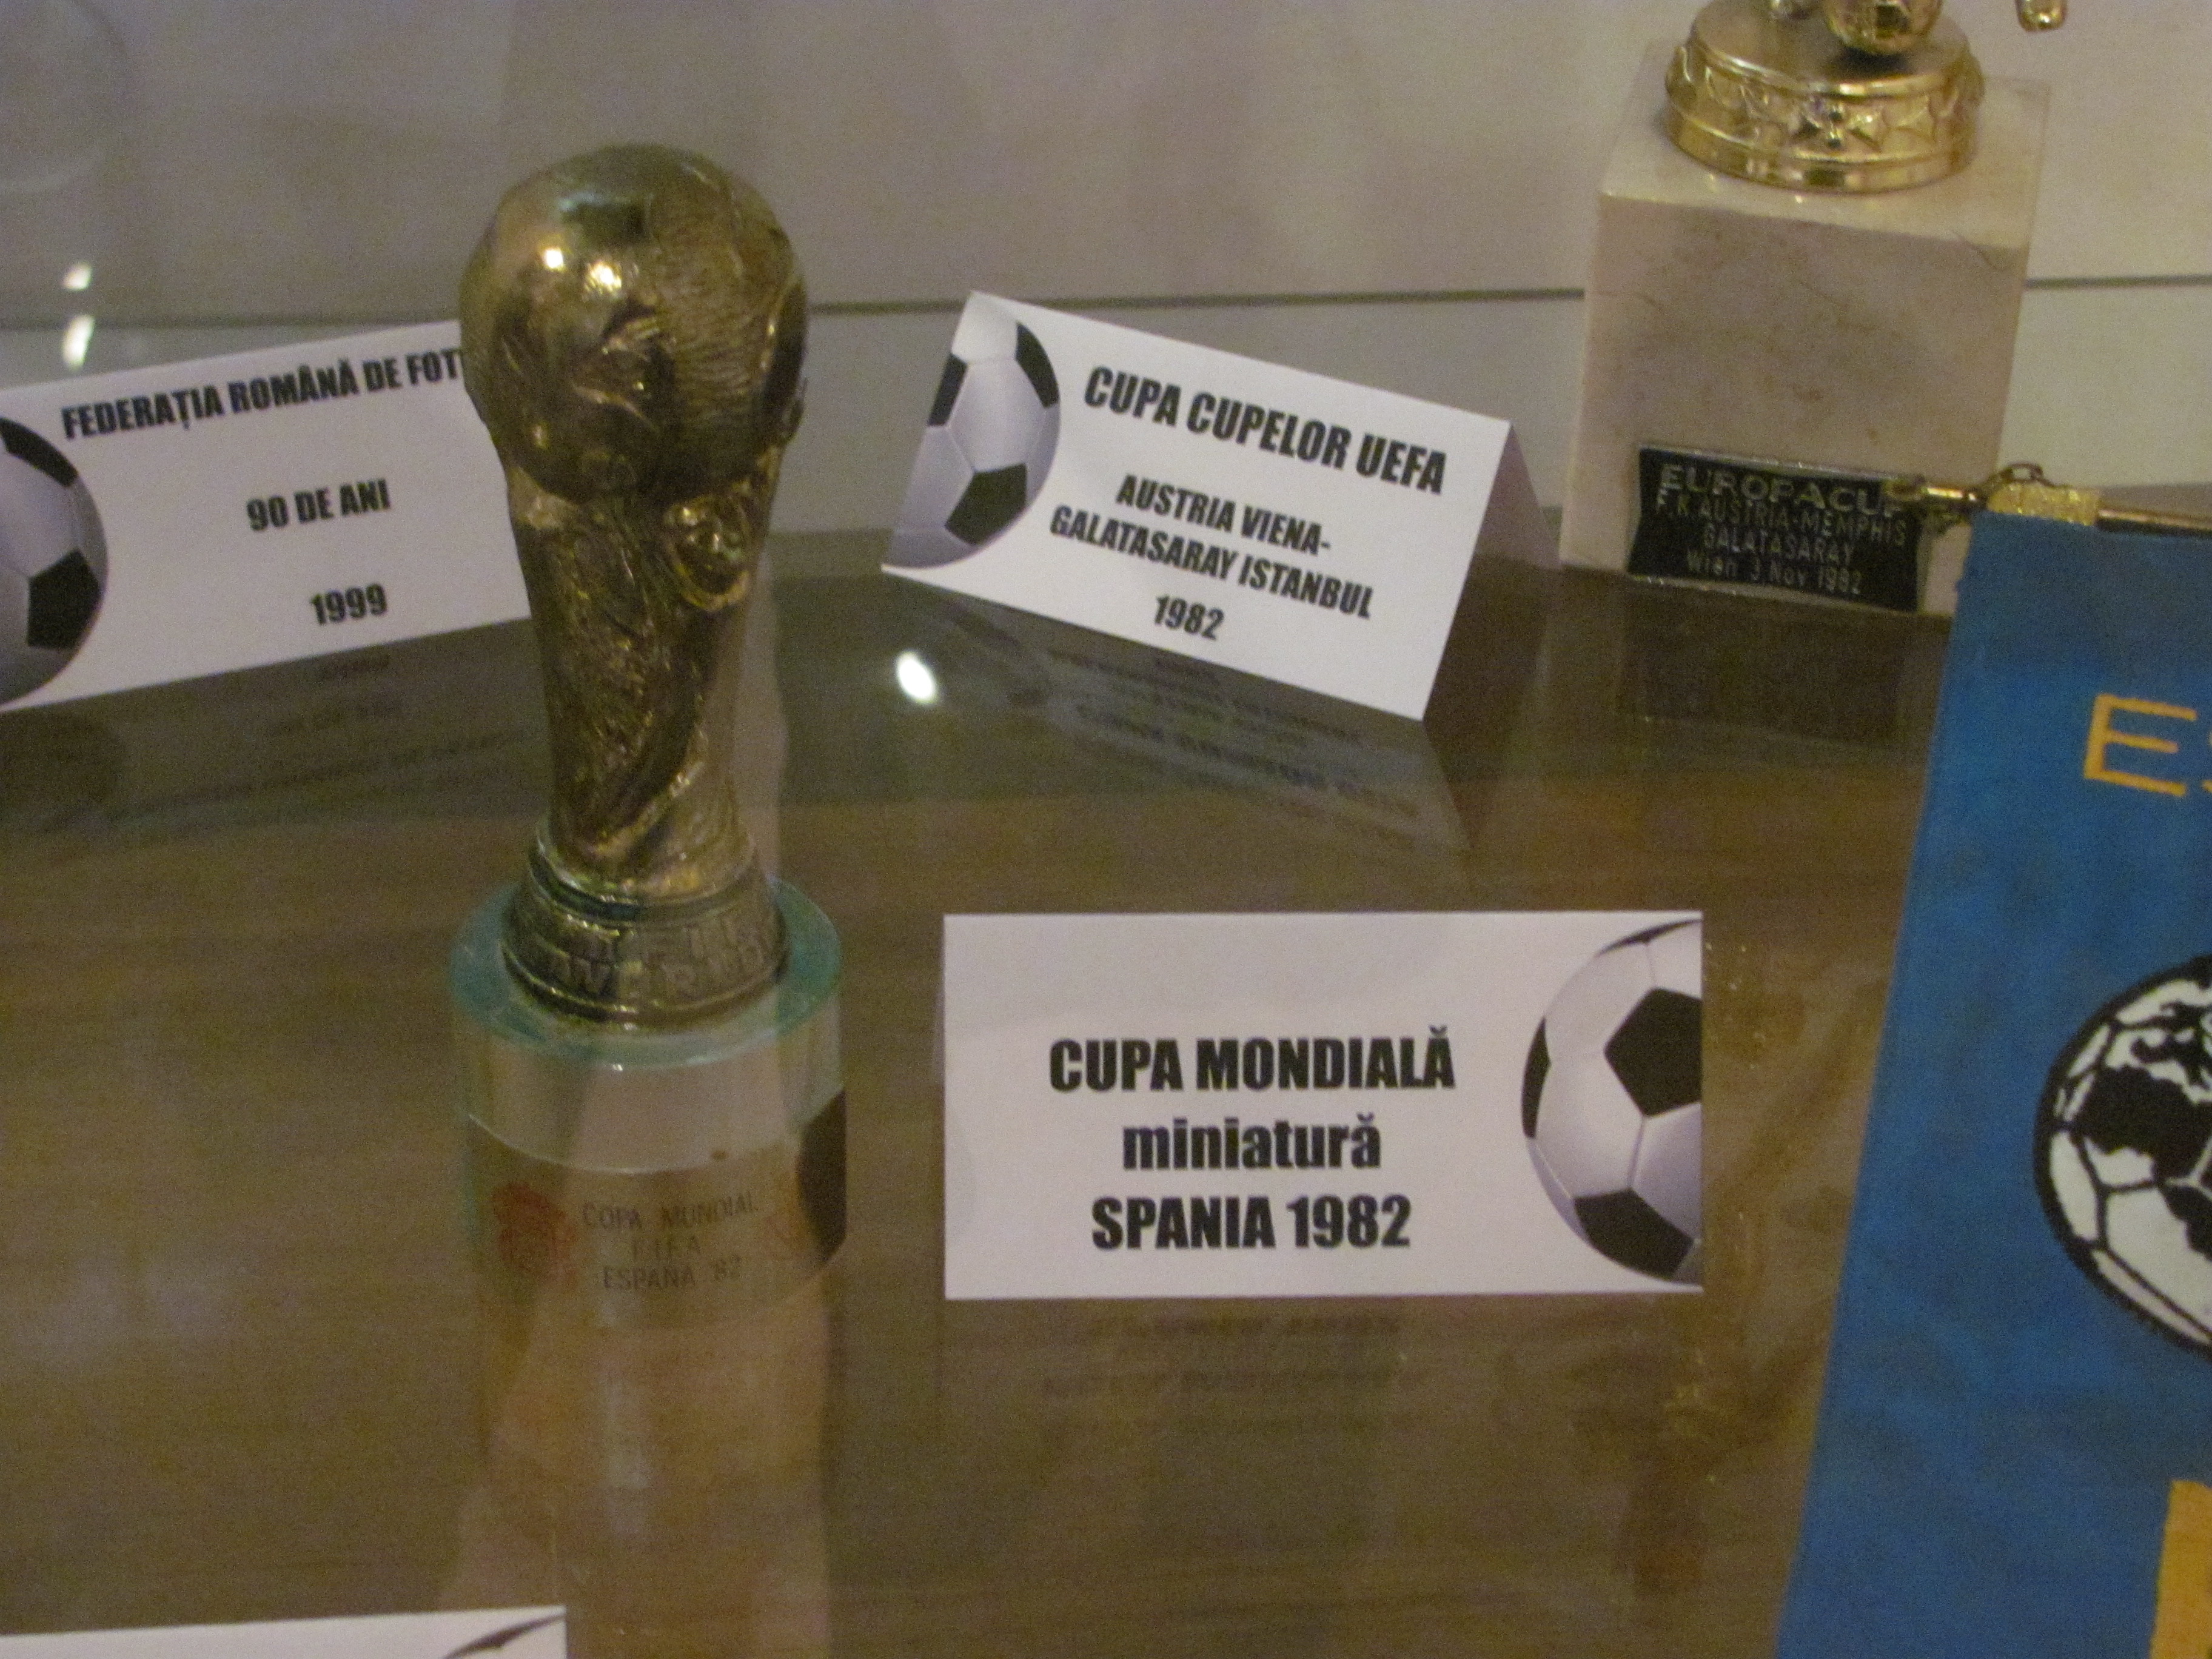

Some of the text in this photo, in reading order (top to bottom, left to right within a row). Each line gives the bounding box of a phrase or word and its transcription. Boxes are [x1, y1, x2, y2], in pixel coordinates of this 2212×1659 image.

[229, 360, 357, 414] ROMÂNĂ
[363, 360, 403, 392] DE
[408, 349, 463, 384] FOT
[1085, 367, 1447, 494] CUPA CUPELOR UEFA
[246, 480, 391, 532] 90 DE ANI
[1116, 474, 1331, 556] AUSTRIA VIENA-
[1050, 506, 1374, 619] GALATASARAY ISTANBUL
[1703, 521, 1855, 564] GALATASARAY
[310, 584, 387, 626] 1999
[1153, 595, 1225, 640] 1982
[1050, 1025, 1455, 1091] CUPA MONDIALĂ
[1123, 1112, 1381, 1170] miniatură
[582, 1202, 643, 1231] COPA
[1092, 1195, 1412, 1250] SPANIA 1982
